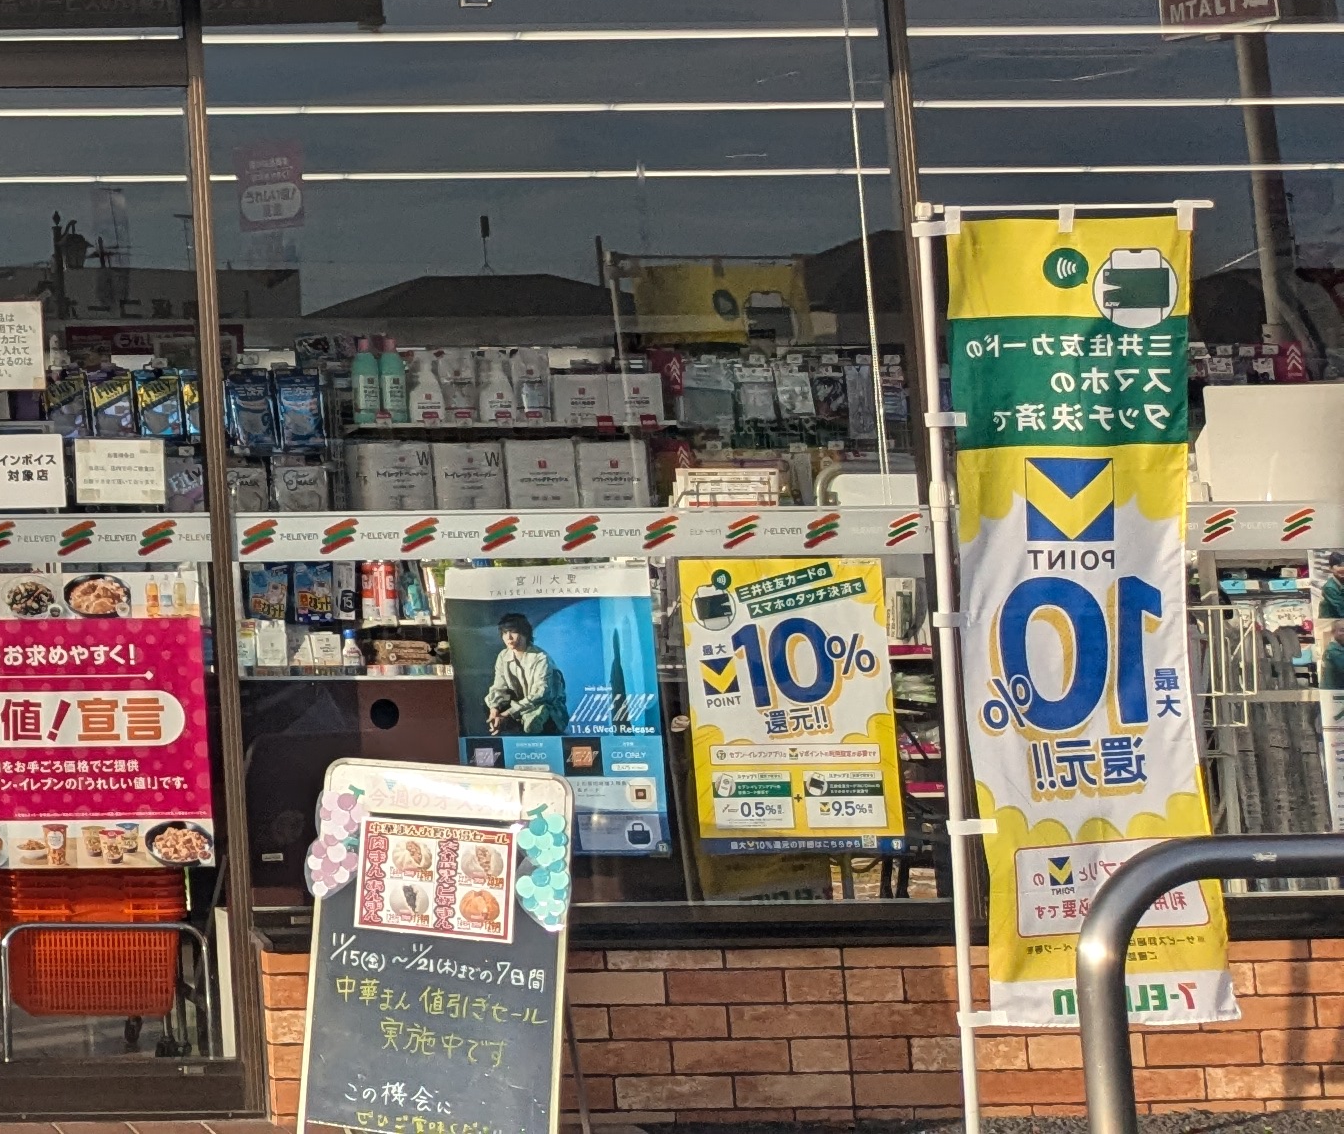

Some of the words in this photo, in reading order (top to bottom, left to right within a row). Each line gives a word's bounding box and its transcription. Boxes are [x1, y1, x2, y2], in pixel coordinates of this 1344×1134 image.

[7, 469, 49, 481] 対象店
[516, 574, 578, 587] 宮川大聖
[739, 567, 827, 601] 三井住友カードの
[489, 588, 528, 597] TAISEI
[536, 586, 600, 595] MIYAKAWA
[750, 580, 862, 617] スマホのタッチ決済で
[702, 643, 727, 656] 最大
[731, 617, 875, 708] 10%
[706, 695, 742, 709] POINT
[571, 725, 591, 734] 11.6
[592, 725, 618, 735] (Wed)
[619, 724, 656, 735] Release
[764, 708, 829, 735] 還元!!
[740, 801, 777, 818] 0.5%
[831, 800, 867, 817] 9.5%
[381, 1016, 509, 1067] 実施中です
[344, 1082, 452, 1116] この機会に
